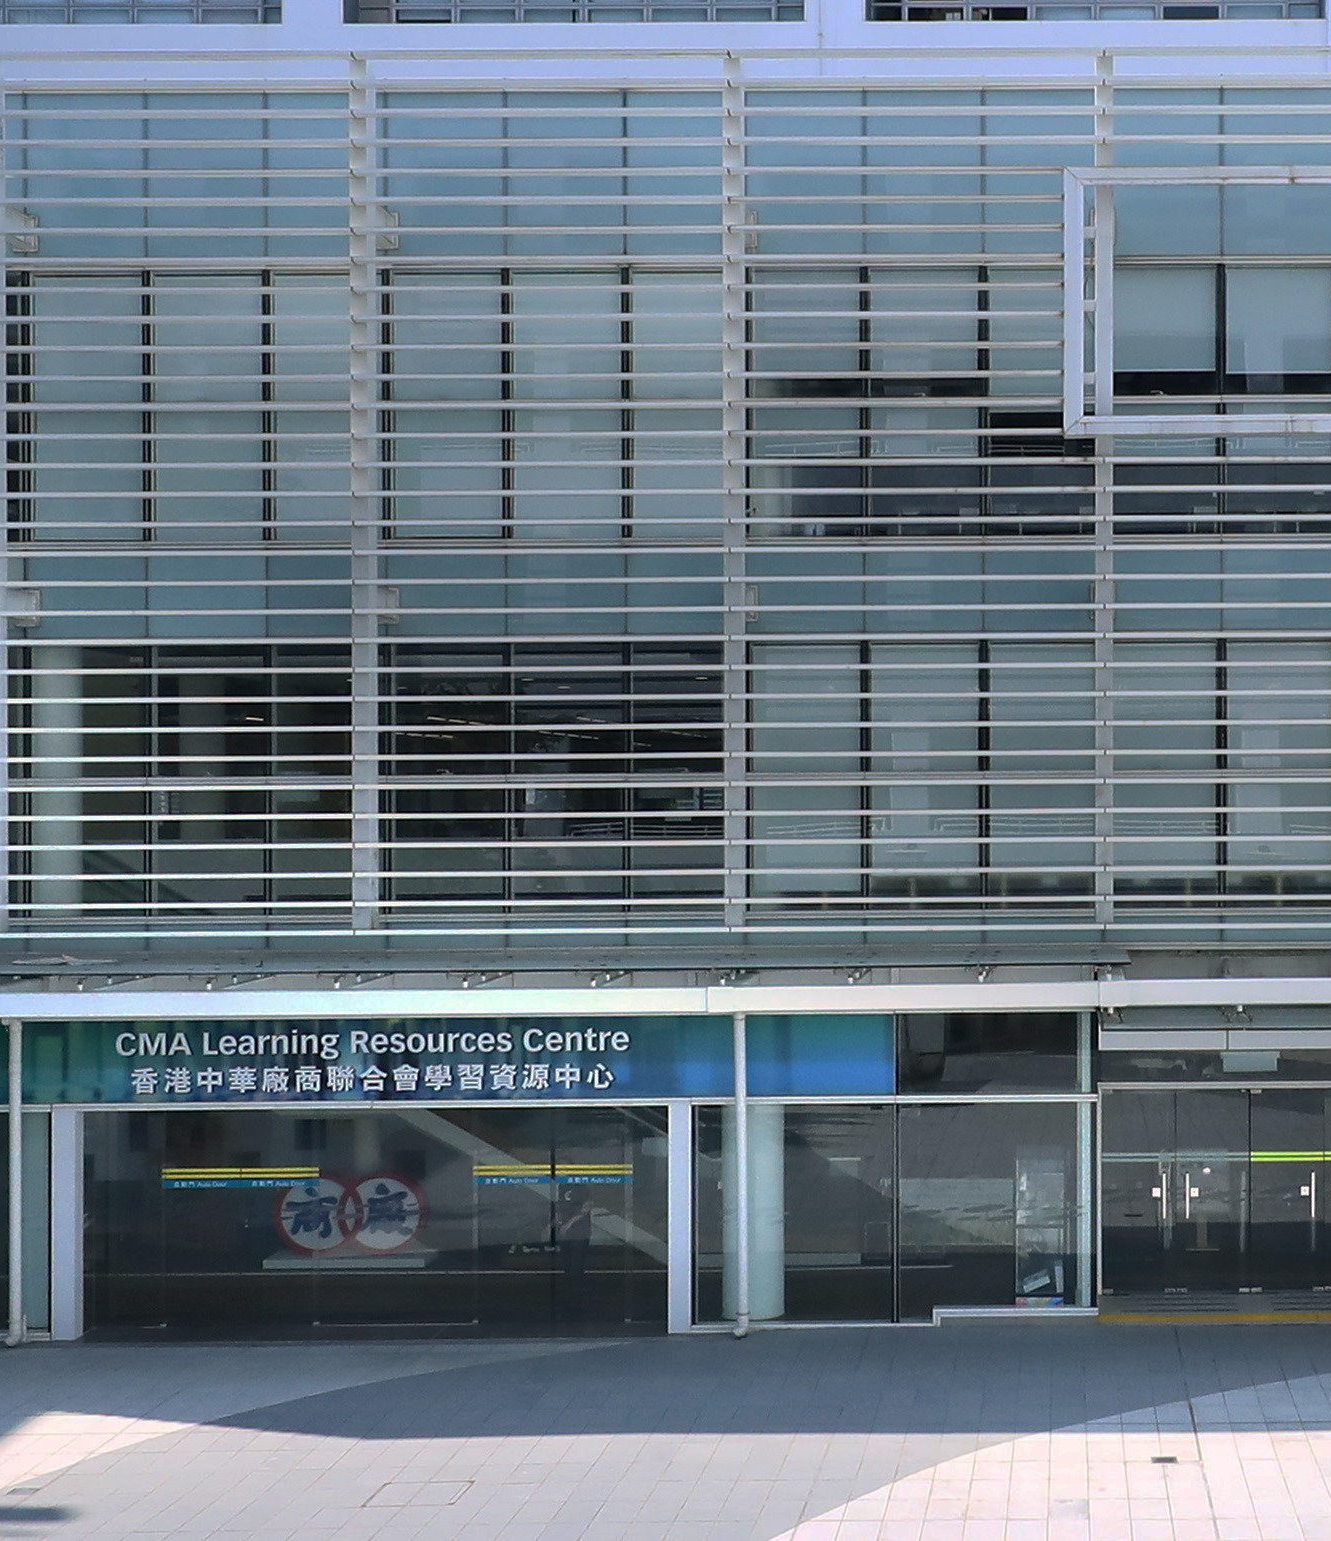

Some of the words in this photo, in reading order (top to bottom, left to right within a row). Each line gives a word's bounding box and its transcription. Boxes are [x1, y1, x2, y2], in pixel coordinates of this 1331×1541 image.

[116, 1032, 192, 1056] CMA
[203, 1029, 340, 1060] Learning
[350, 1030, 513, 1054] Resources
[523, 1027, 630, 1052] Centre
[131, 1064, 614, 1094] 香港中華廠商聯合會學習資源中心
